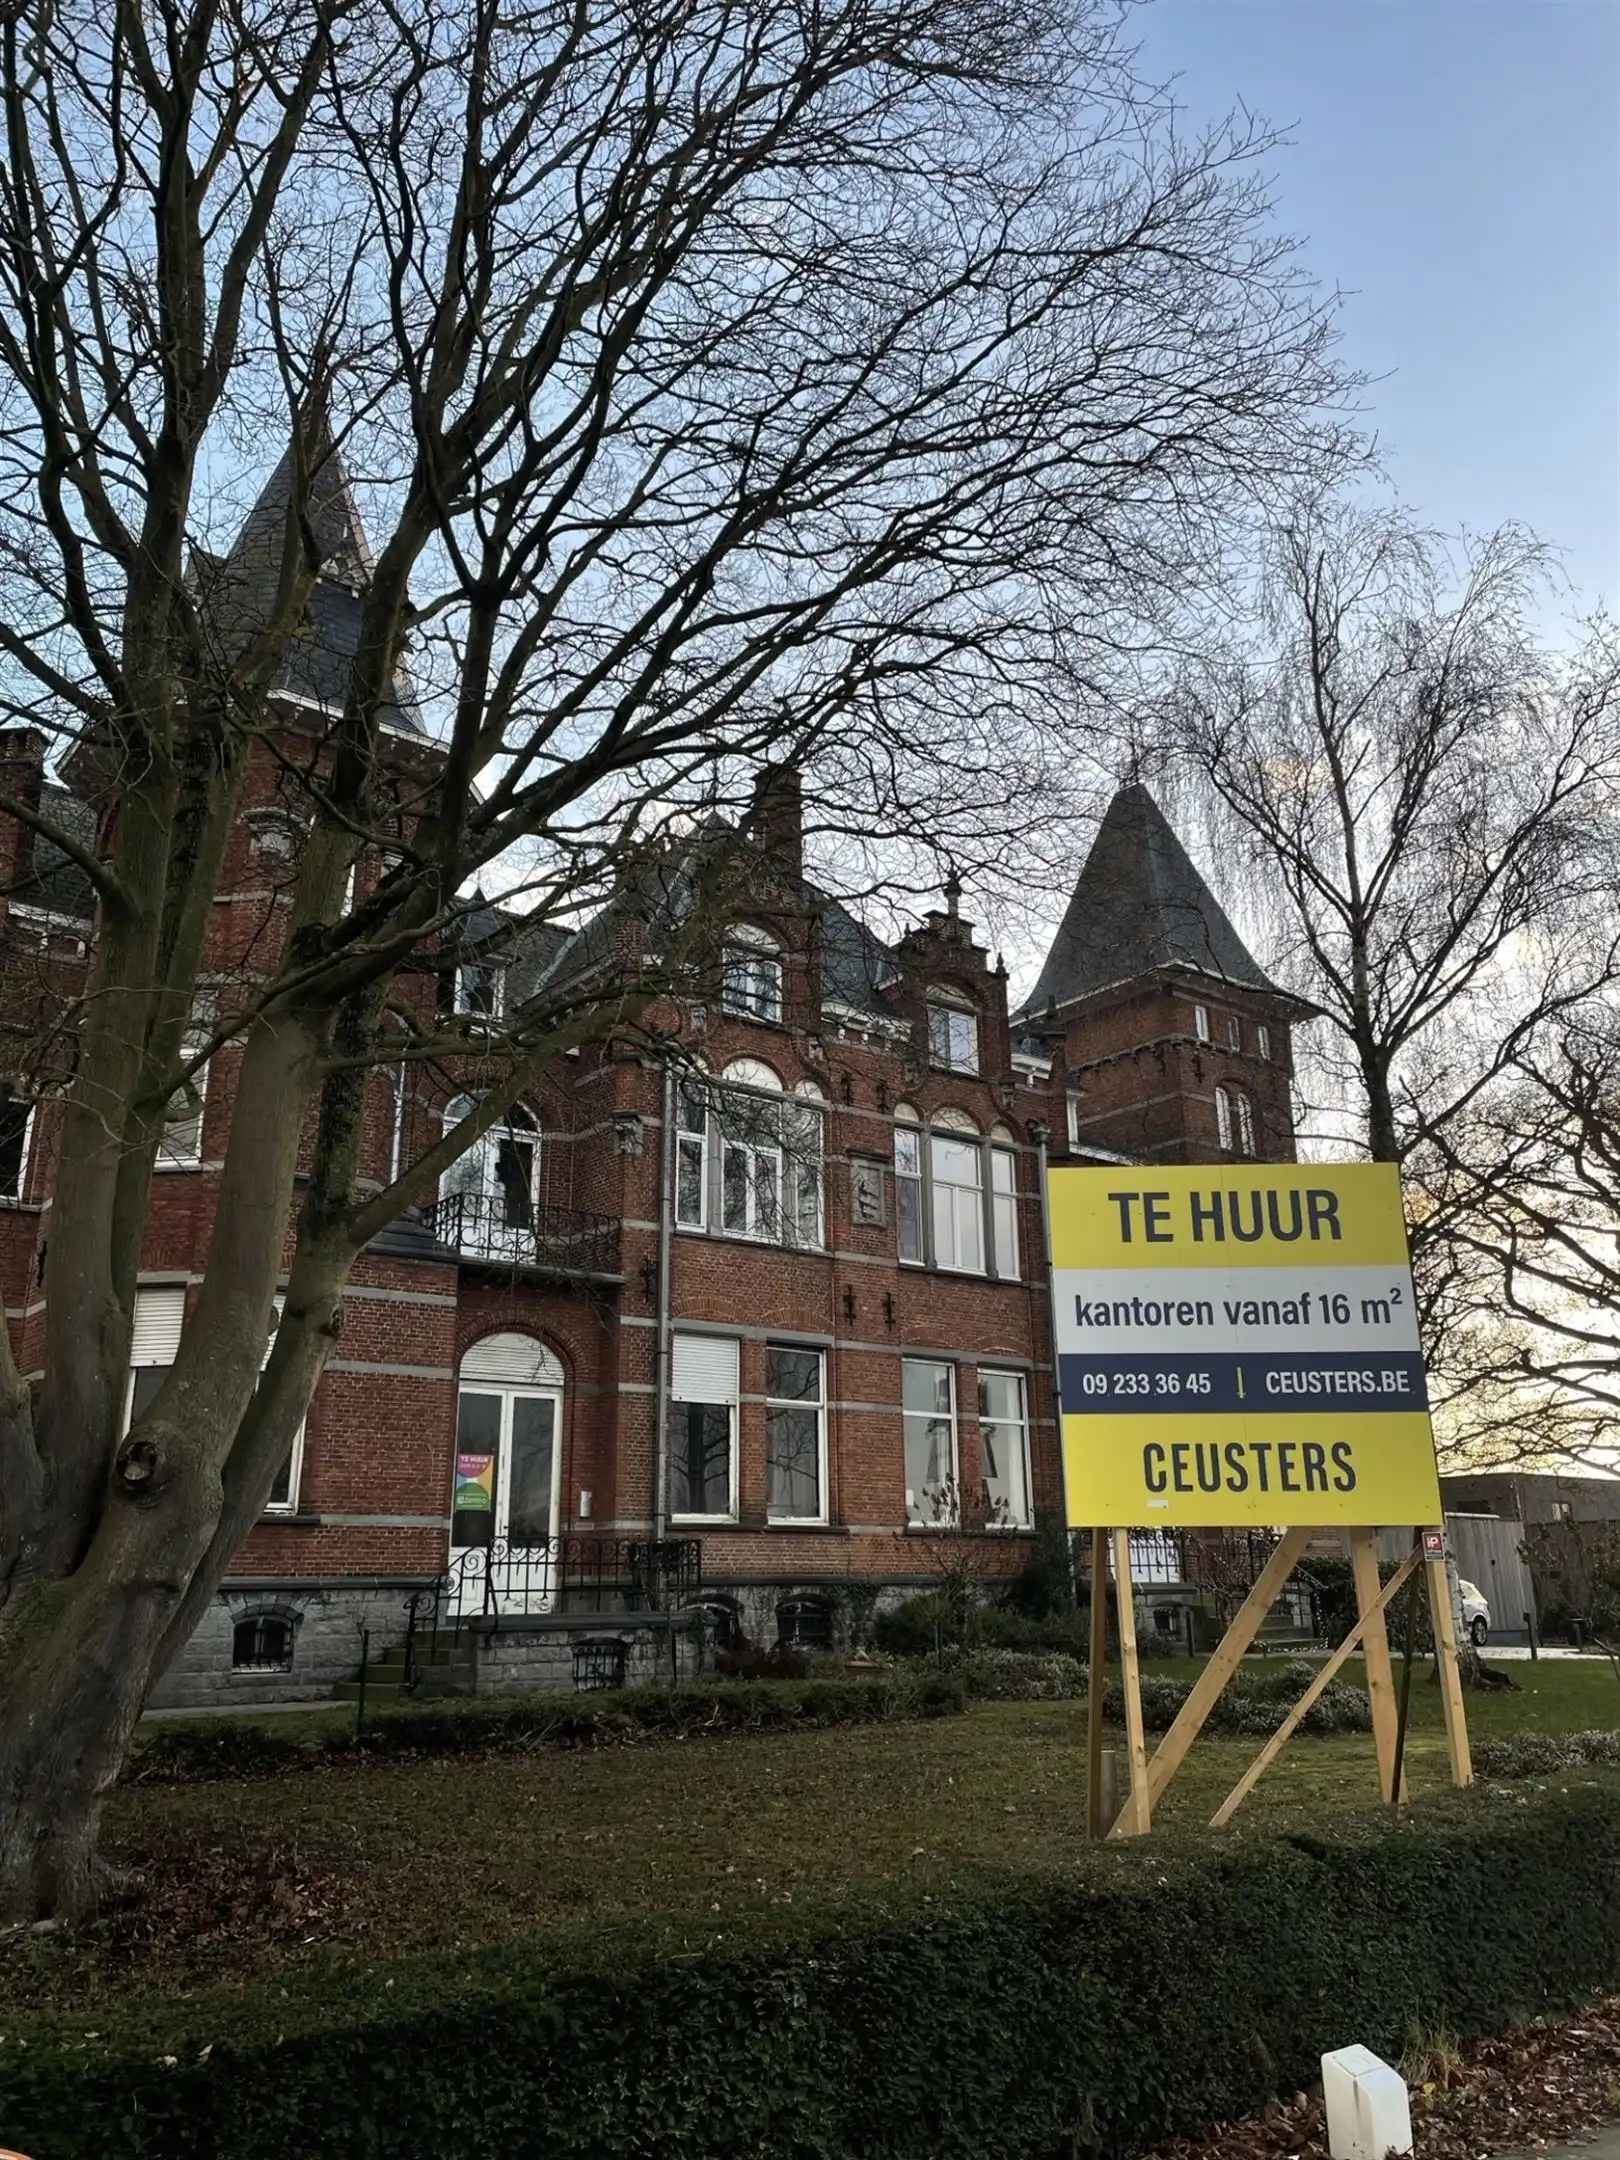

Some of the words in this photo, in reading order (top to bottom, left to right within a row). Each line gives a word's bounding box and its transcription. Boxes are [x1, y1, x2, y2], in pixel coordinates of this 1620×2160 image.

[1108, 1192, 1174, 1243] TE
[1190, 1189, 1342, 1242] HUUR
[1075, 1294, 1214, 1327] kantoren
[1223, 1292, 1311, 1326] vanaf
[1318, 1293, 1351, 1325] 16
[1082, 1373, 1108, 1395] 09
[1113, 1373, 1151, 1394] 233
[1155, 1373, 1181, 1394] 36
[1185, 1373, 1212, 1394] 45
[1266, 1370, 1411, 1394] CEUSTERS.BE
[1143, 1441, 1357, 1493] CEUSTERS
